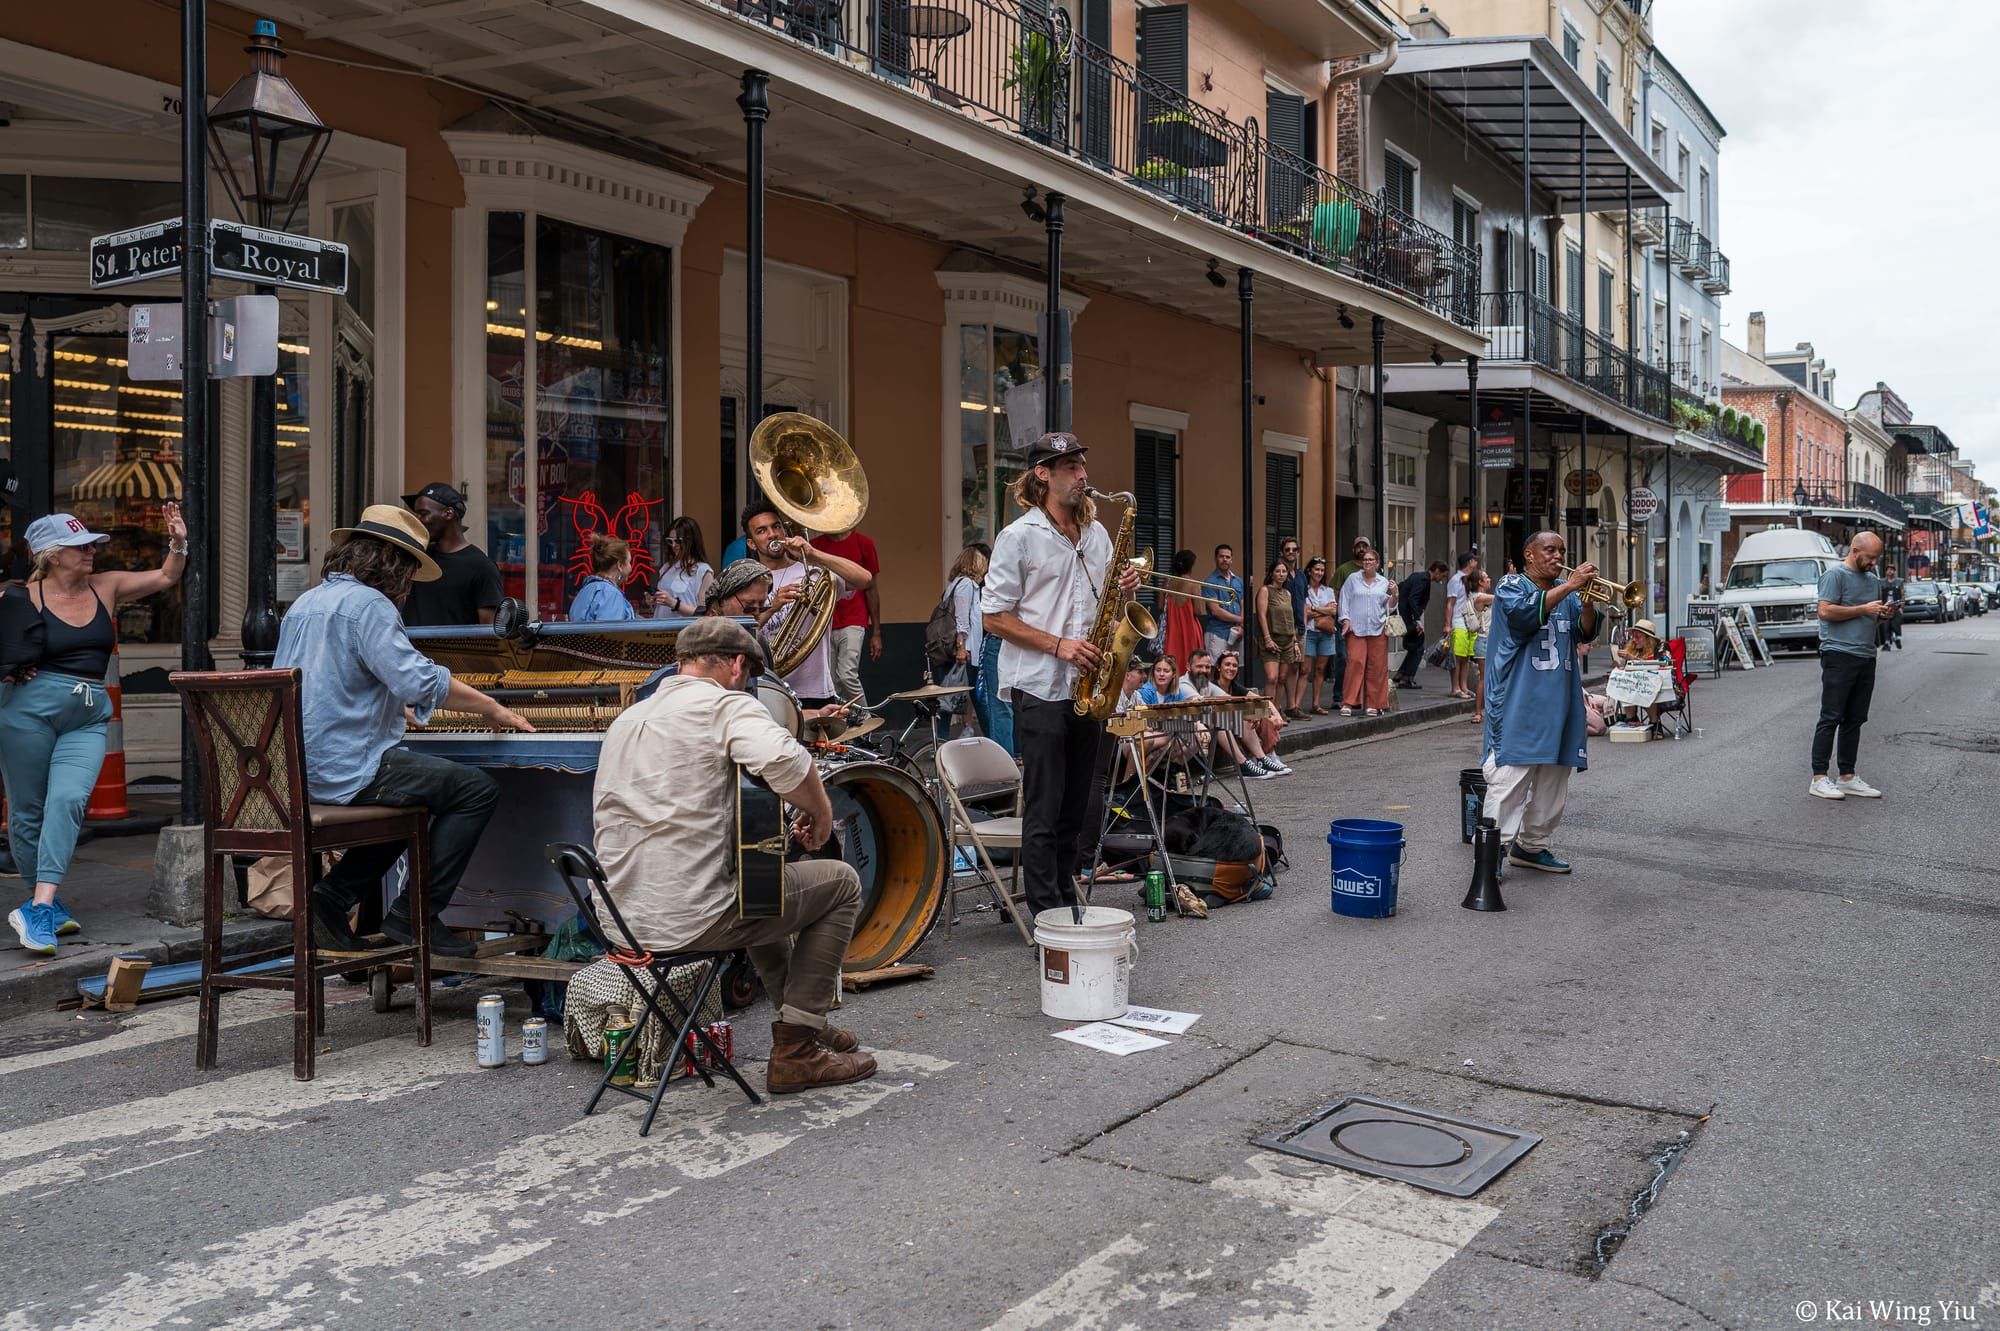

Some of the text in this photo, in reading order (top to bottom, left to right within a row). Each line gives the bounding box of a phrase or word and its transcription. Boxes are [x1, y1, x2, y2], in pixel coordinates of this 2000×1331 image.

[116, 229, 158, 245] Rue St. Pierre
[257, 231, 307, 249] Rue Royale
[95, 245, 178, 279] St. Peter
[241, 243, 321, 280] Royal
[1568, 479, 1599, 489] TORS
[1626, 499, 1657, 508] OODOO
[1332, 875, 1375, 895] LOWE'S
